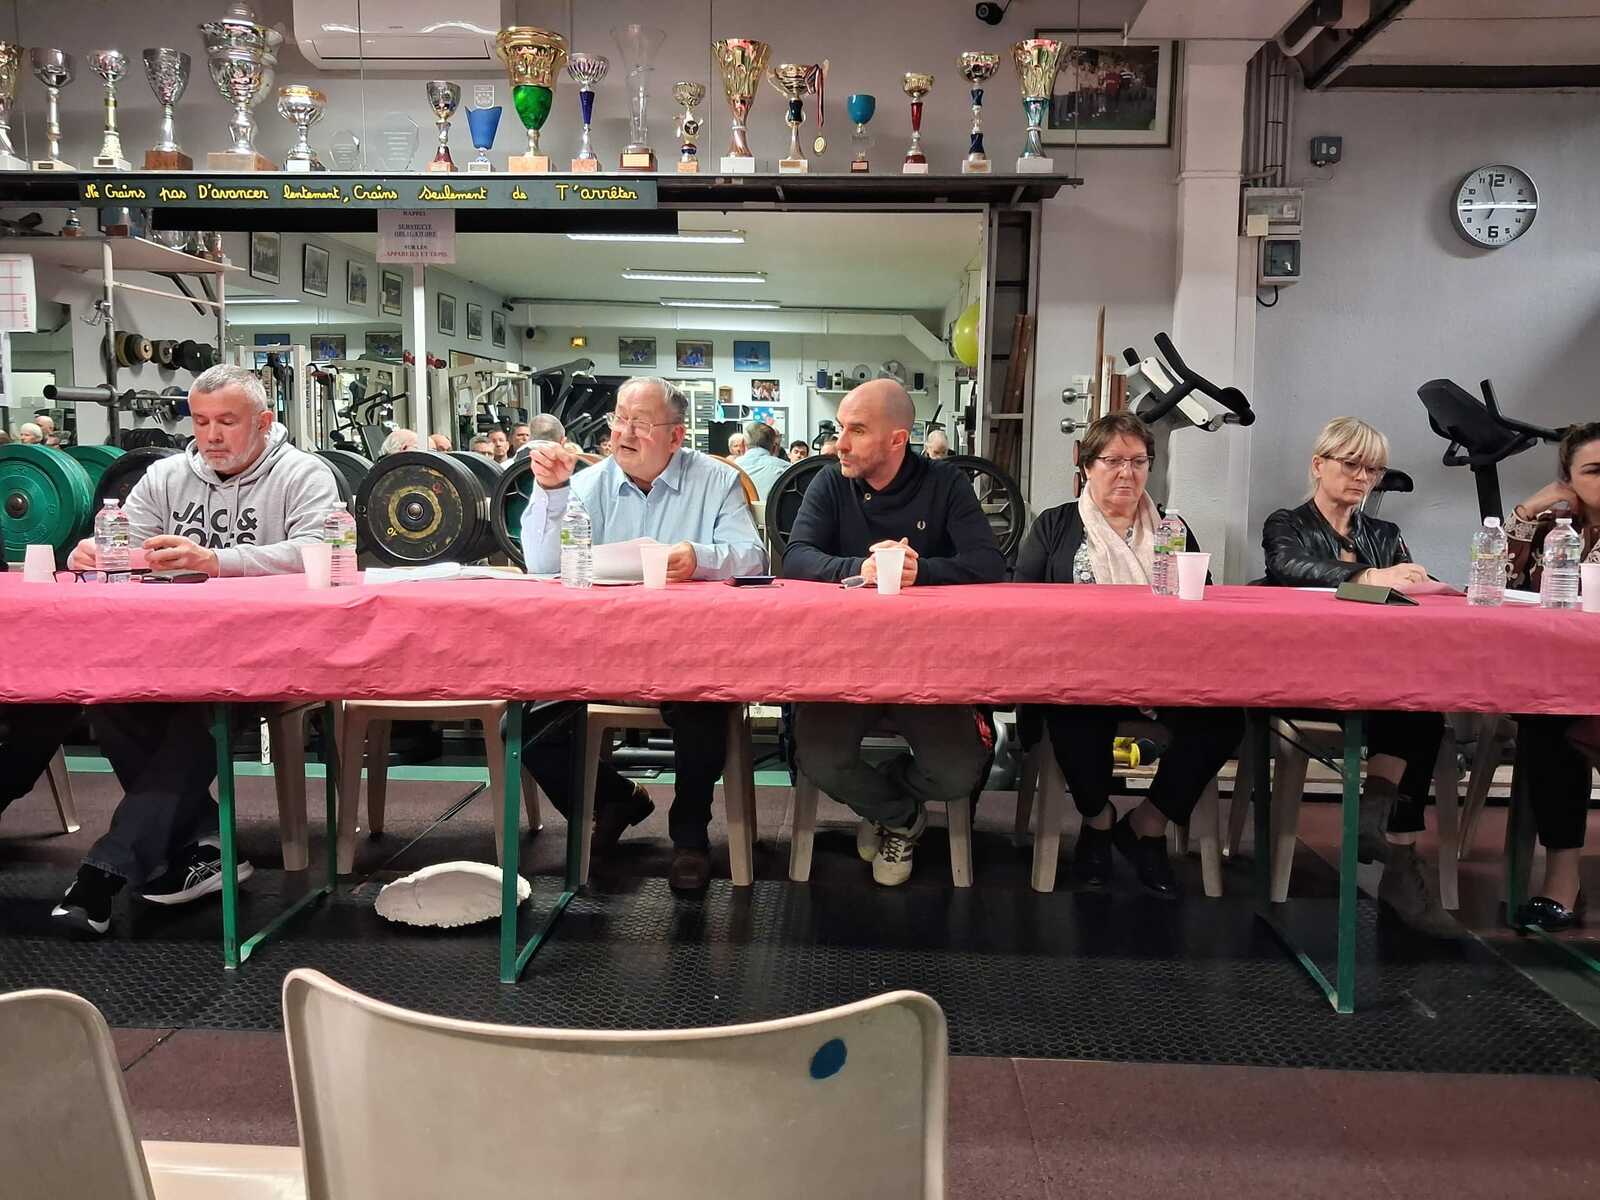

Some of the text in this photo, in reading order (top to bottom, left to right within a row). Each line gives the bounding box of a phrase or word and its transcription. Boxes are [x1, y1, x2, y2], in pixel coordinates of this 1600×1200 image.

[1488, 173, 1506, 188] 12
[159, 187, 188, 202] pas
[198, 183, 270, 200] D'avancer
[512, 185, 528, 200] de
[555, 184, 638, 200] T'arrêter
[1487, 225, 1499, 239] 6
[236, 507, 258, 531] &
